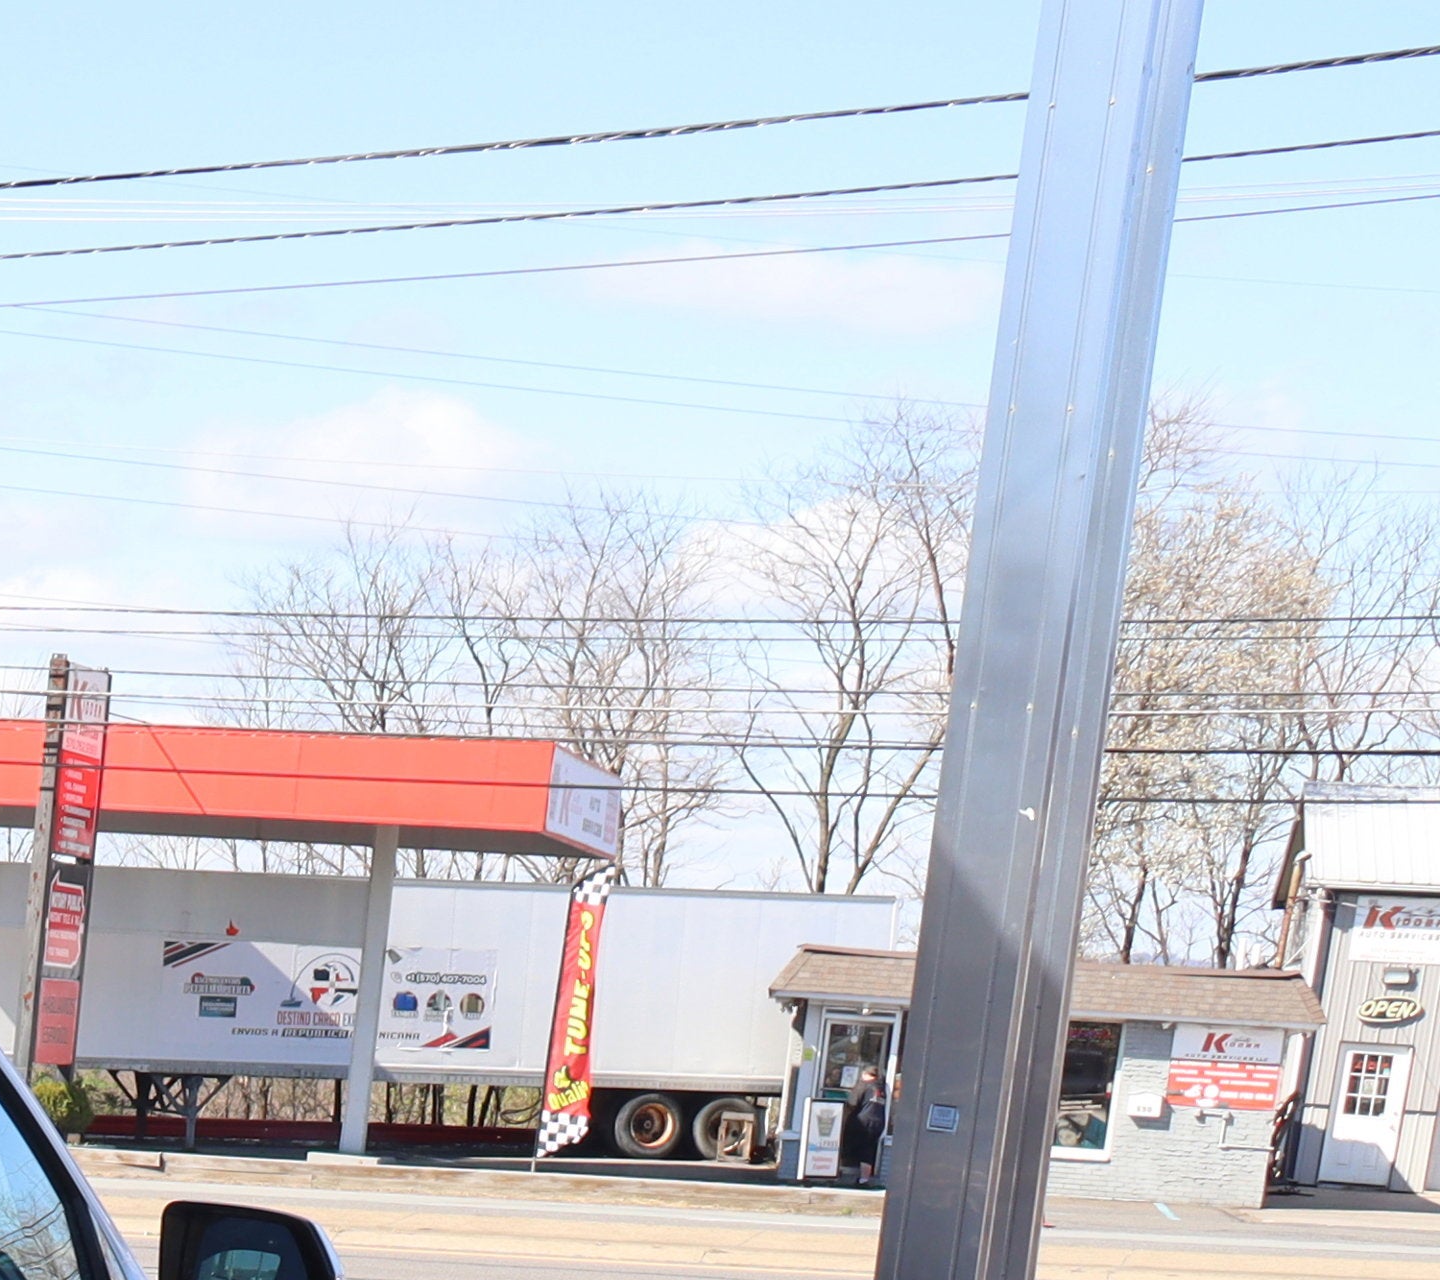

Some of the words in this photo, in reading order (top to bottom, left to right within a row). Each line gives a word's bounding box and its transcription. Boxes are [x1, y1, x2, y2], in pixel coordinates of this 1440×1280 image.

[1360, 1000, 1416, 1020] OPEN
[277, 1011, 310, 1026] DESTINO
[312, 1012, 341, 1026] CARGO
[232, 1028, 268, 1036] ENVIOS
